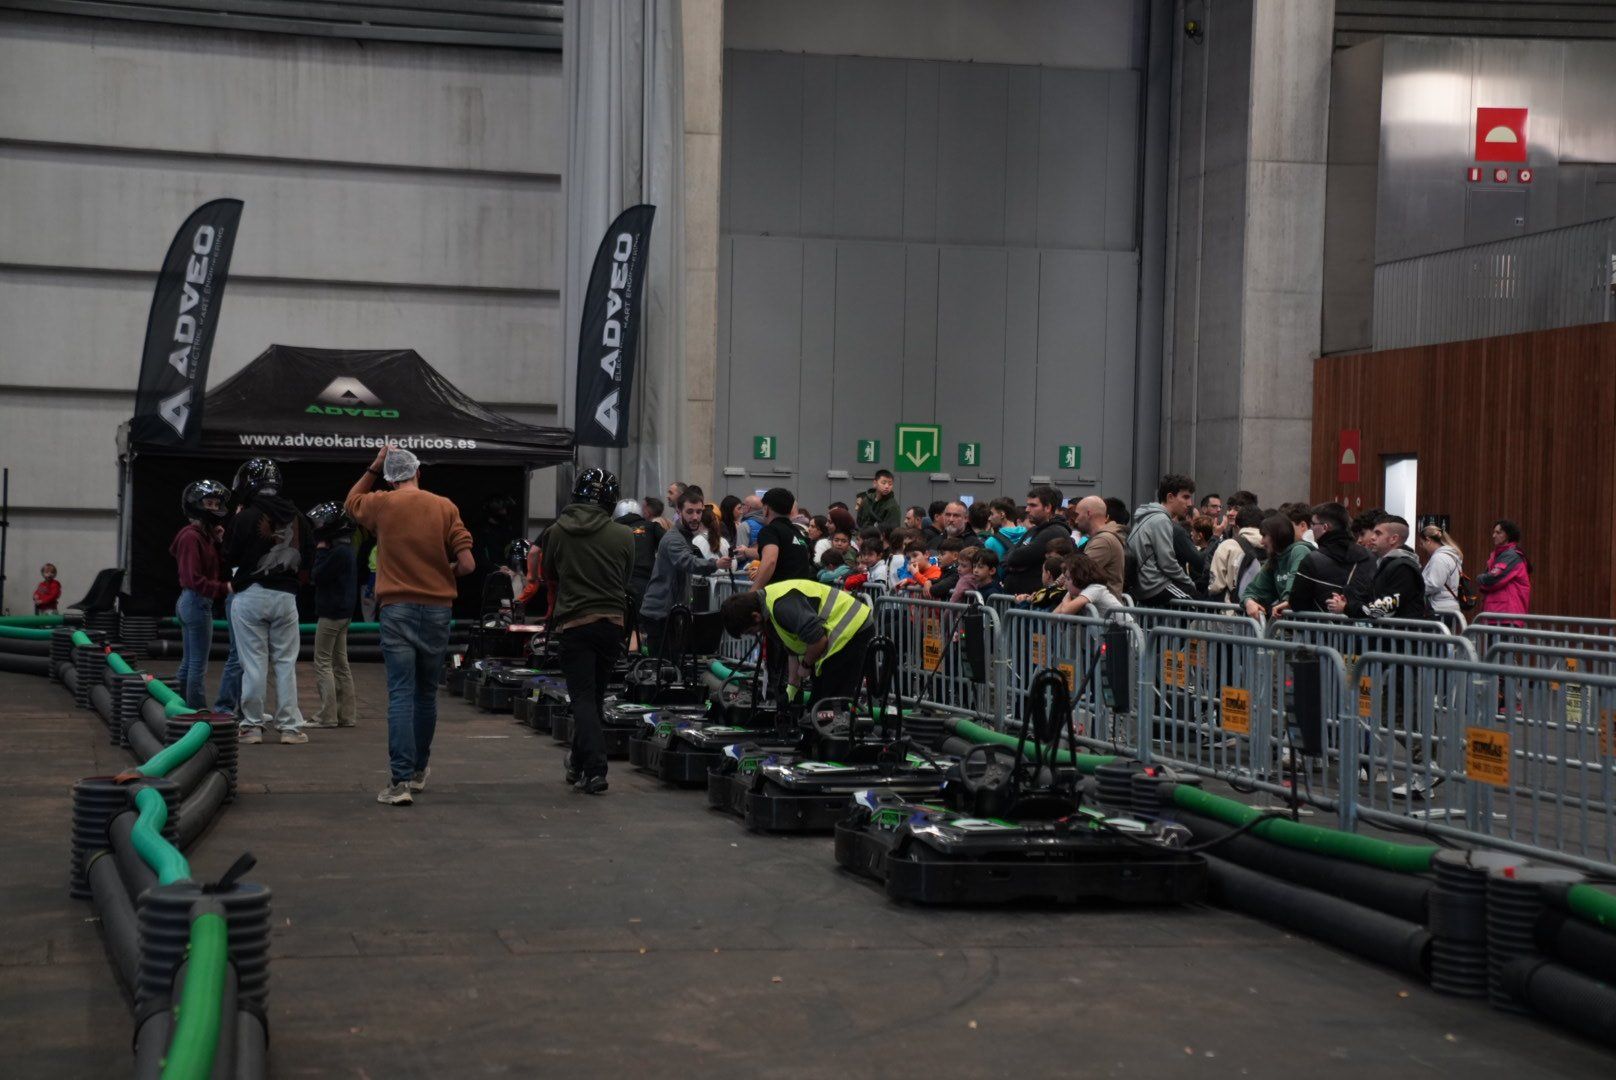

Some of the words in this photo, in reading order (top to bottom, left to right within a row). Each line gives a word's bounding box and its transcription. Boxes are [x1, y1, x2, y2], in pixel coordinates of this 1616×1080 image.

[168, 224, 215, 378] ADVEO
[600, 232, 633, 381] ADVEO
[239, 433, 477, 450] www.adveokartselectricos.es
[304, 404, 400, 418] ADVEO
